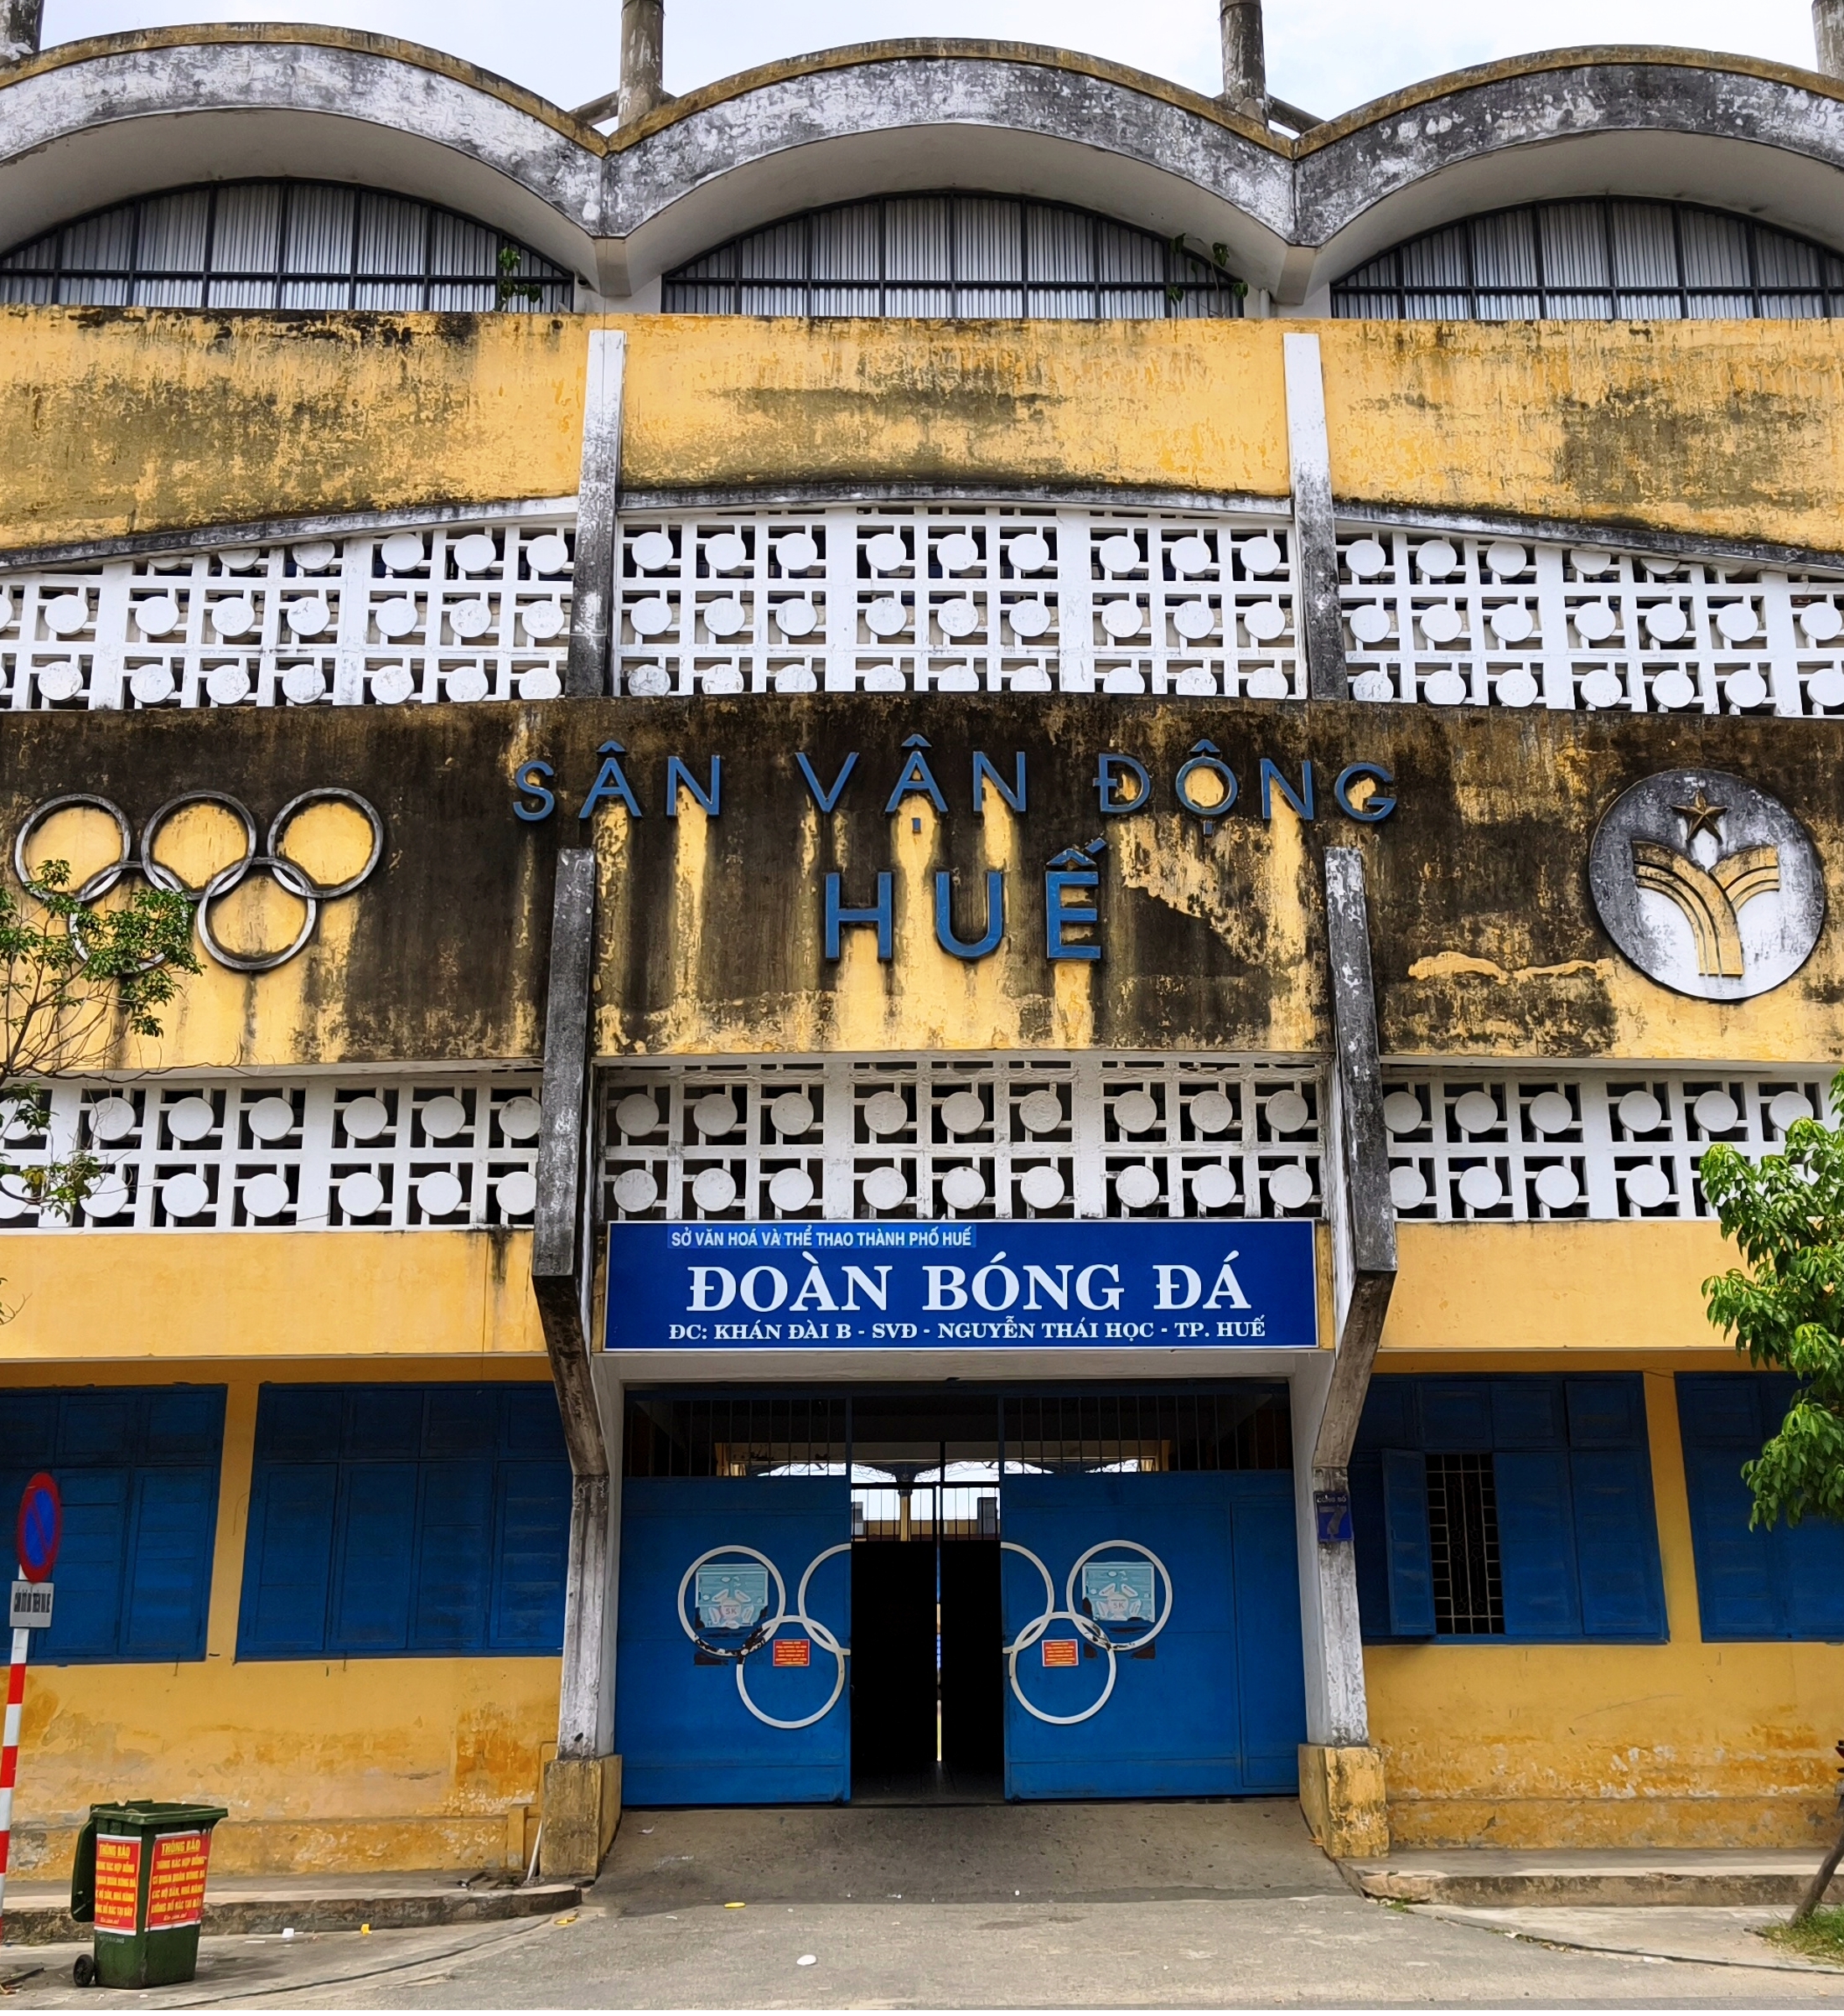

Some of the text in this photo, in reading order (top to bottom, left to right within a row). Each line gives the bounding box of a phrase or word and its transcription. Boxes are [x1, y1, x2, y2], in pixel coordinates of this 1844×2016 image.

[512, 733, 1397, 836] SÂN VẬN ĐỘNG
[825, 837, 1107, 960] HUẾ
[671, 1225, 971, 1247] SỞ VĂN HOÁ VÀ THỂ THAO THÀNH PHỐ HUẾ
[686, 1250, 1252, 1313] ĐOÀN BÓNG ĐÁ
[669, 1324, 707, 1340] ĐC:
[713, 1319, 781, 1340] KHÁN
[788, 1319, 829, 1340] ĐÀI
[837, 1324, 852, 1339] B
[872, 1324, 917, 1340] SVĐ
[938, 1315, 1035, 1340] NGUYỄN
[1042, 1317, 1098, 1339] THÁI
[1105, 1322, 1154, 1341] HỌC
[1174, 1321, 1209, 1338] TP.
[1217, 1314, 1266, 1337] HUẾ
[1319, 1506, 1347, 1535] 7
